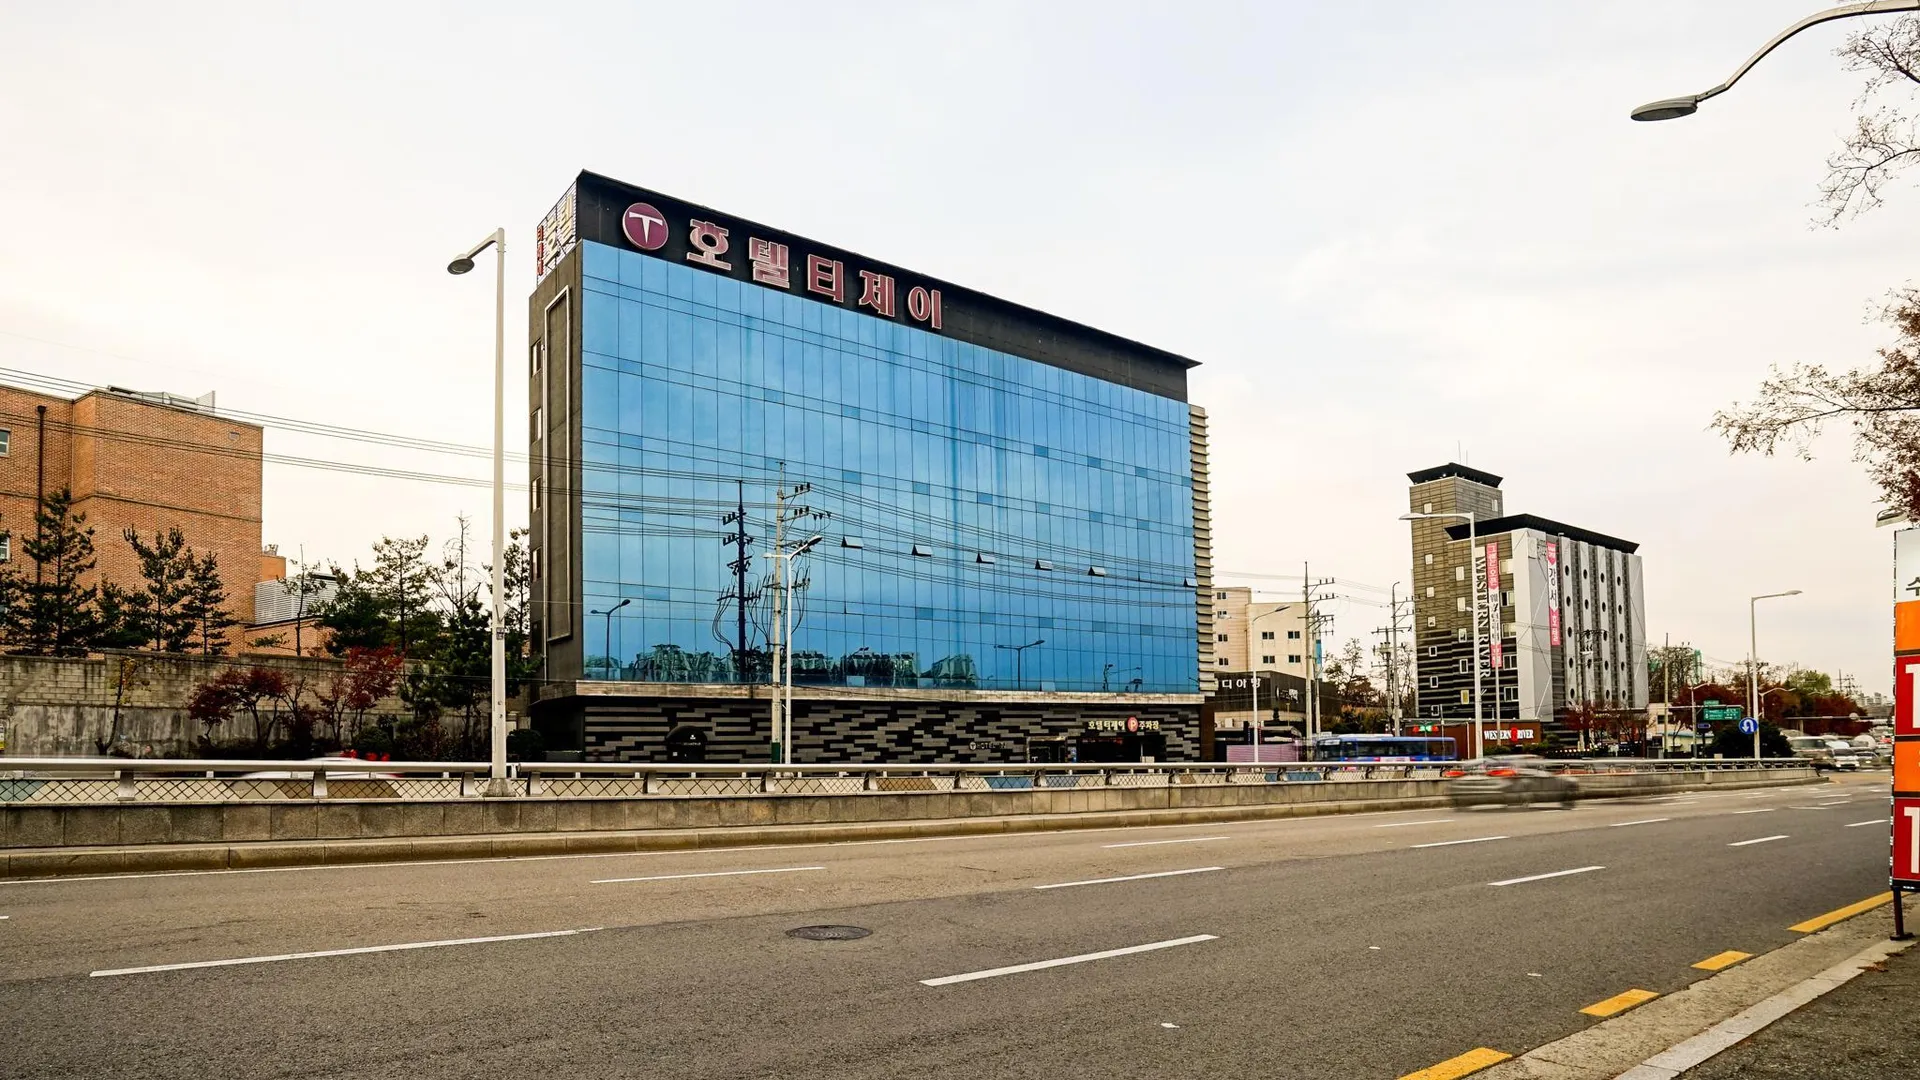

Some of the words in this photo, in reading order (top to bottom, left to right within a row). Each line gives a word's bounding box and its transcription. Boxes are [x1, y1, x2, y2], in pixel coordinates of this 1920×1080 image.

[686, 218, 943, 330] 호텔티제이
[1475, 557, 1488, 630] WESTERN
[1549, 567, 1558, 606] 강서
[1478, 634, 1491, 679] RIVER
[1138, 720, 1159, 731] 주차장
[1484, 730, 1512, 740] WESERN
[1904, 806, 1920, 874] 1
